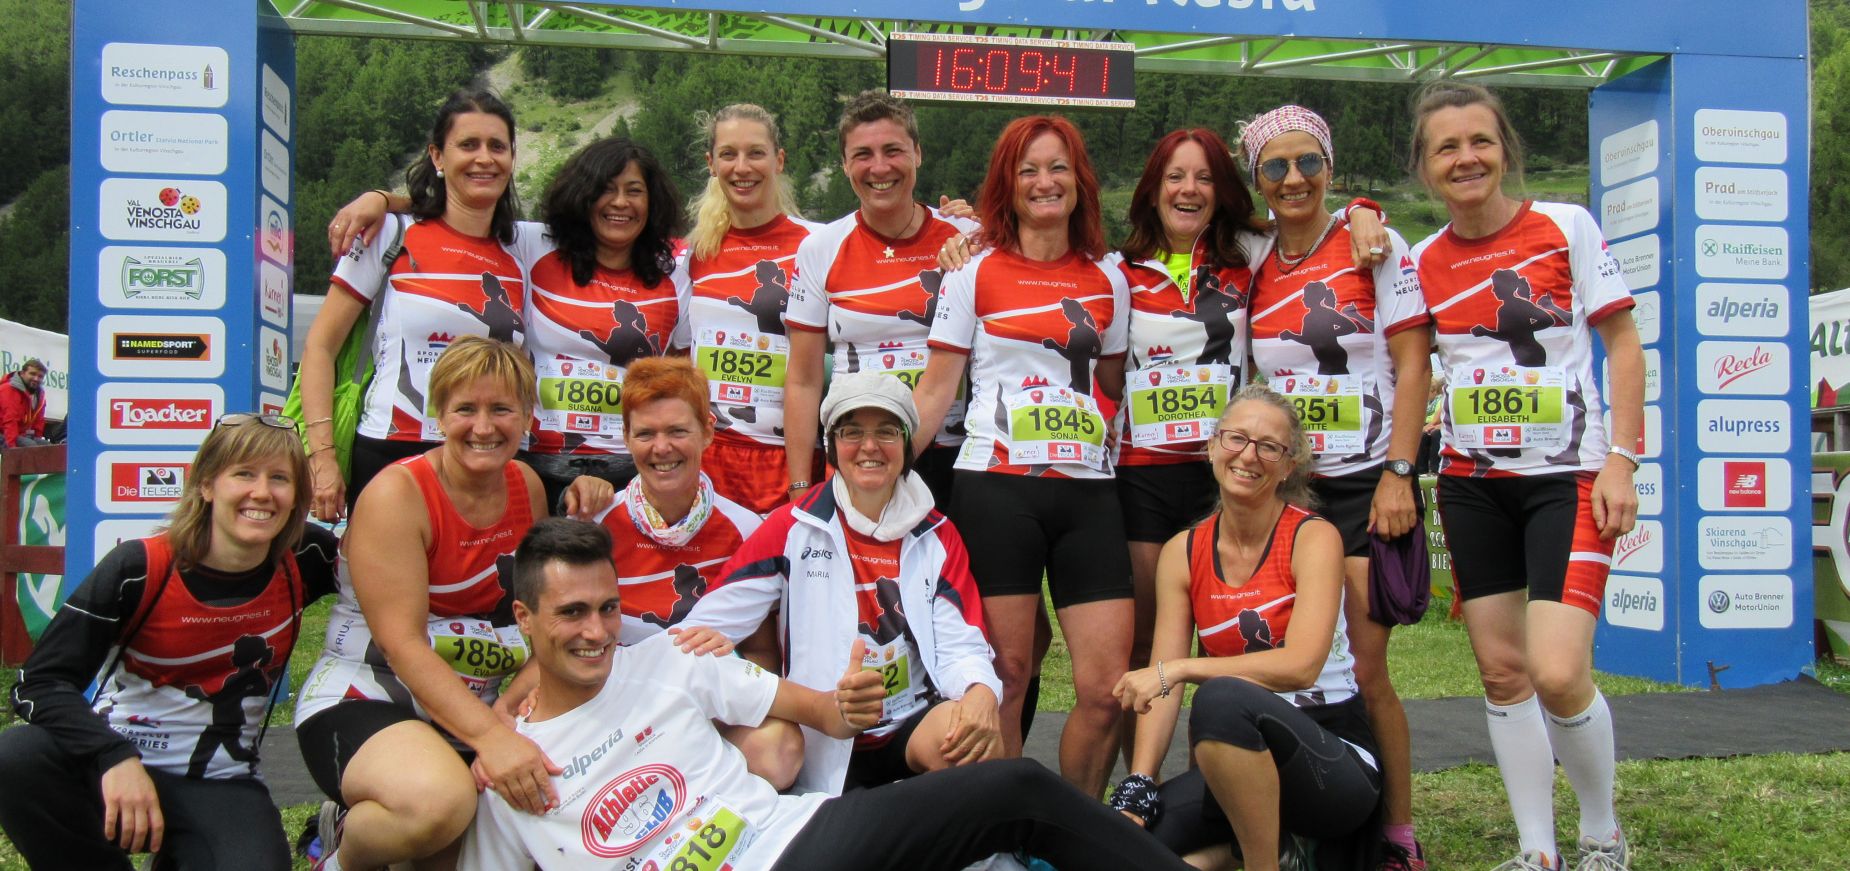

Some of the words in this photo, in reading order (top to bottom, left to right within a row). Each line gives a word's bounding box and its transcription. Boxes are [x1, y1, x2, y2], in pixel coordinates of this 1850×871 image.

[111, 66, 198, 81] Reschenpass
[936, 48, 1109, 93] 16:09:41
[110, 130, 154, 142] Ortler
[1702, 126, 1779, 140] Obervinschgau
[1604, 138, 1654, 163] Obervinschgau
[1705, 182, 1735, 194] Prad
[127, 207, 183, 218] VENOSTA
[1607, 200, 1626, 216] Prad
[127, 218, 200, 229] VINSCHGAU
[1722, 243, 1783, 256] Raiffeisen
[876, 254, 936, 264] www.neugries.it
[1450, 249, 1516, 270] www.neugries.it
[1622, 257, 1634, 265] Auto
[1635, 253, 1654, 262] Brenner
[128, 268, 198, 287] FORST
[1622, 264, 1651, 276] MotorUnion
[1396, 284, 1422, 296] NEUG
[1707, 296, 1778, 323] alperia
[130, 340, 192, 349] NAMEDSPORT
[710, 350, 772, 377] 1852
[1714, 345, 1772, 379] Recla
[722, 374, 753, 383] EVELYN
[555, 380, 621, 406] 1860
[1147, 386, 1216, 414] 1854
[568, 404, 602, 412] SUSANA
[1468, 388, 1539, 415] 1861
[113, 401, 207, 426] Loacker
[1158, 411, 1206, 421] DOROTHEA
[1294, 398, 1338, 422] 851
[1028, 408, 1094, 434] 1845
[1478, 415, 1529, 424] ELISABETH
[1708, 416, 1780, 436] alupress
[118, 486, 137, 496] Die
[142, 487, 182, 496] TELSER
[1616, 523, 1652, 555] Recla
[1706, 527, 1746, 536] Skiarena
[1711, 538, 1757, 549] Vinschgau
[812, 549, 833, 560] asics
[806, 570, 830, 579] MARIA
[1612, 589, 1656, 614] alperia
[182, 608, 272, 625] www.neugries.it
[453, 638, 515, 670] 1858
[562, 727, 624, 780] alperia
[592, 775, 660, 842] Athletic
[634, 788, 674, 840] CLUB
